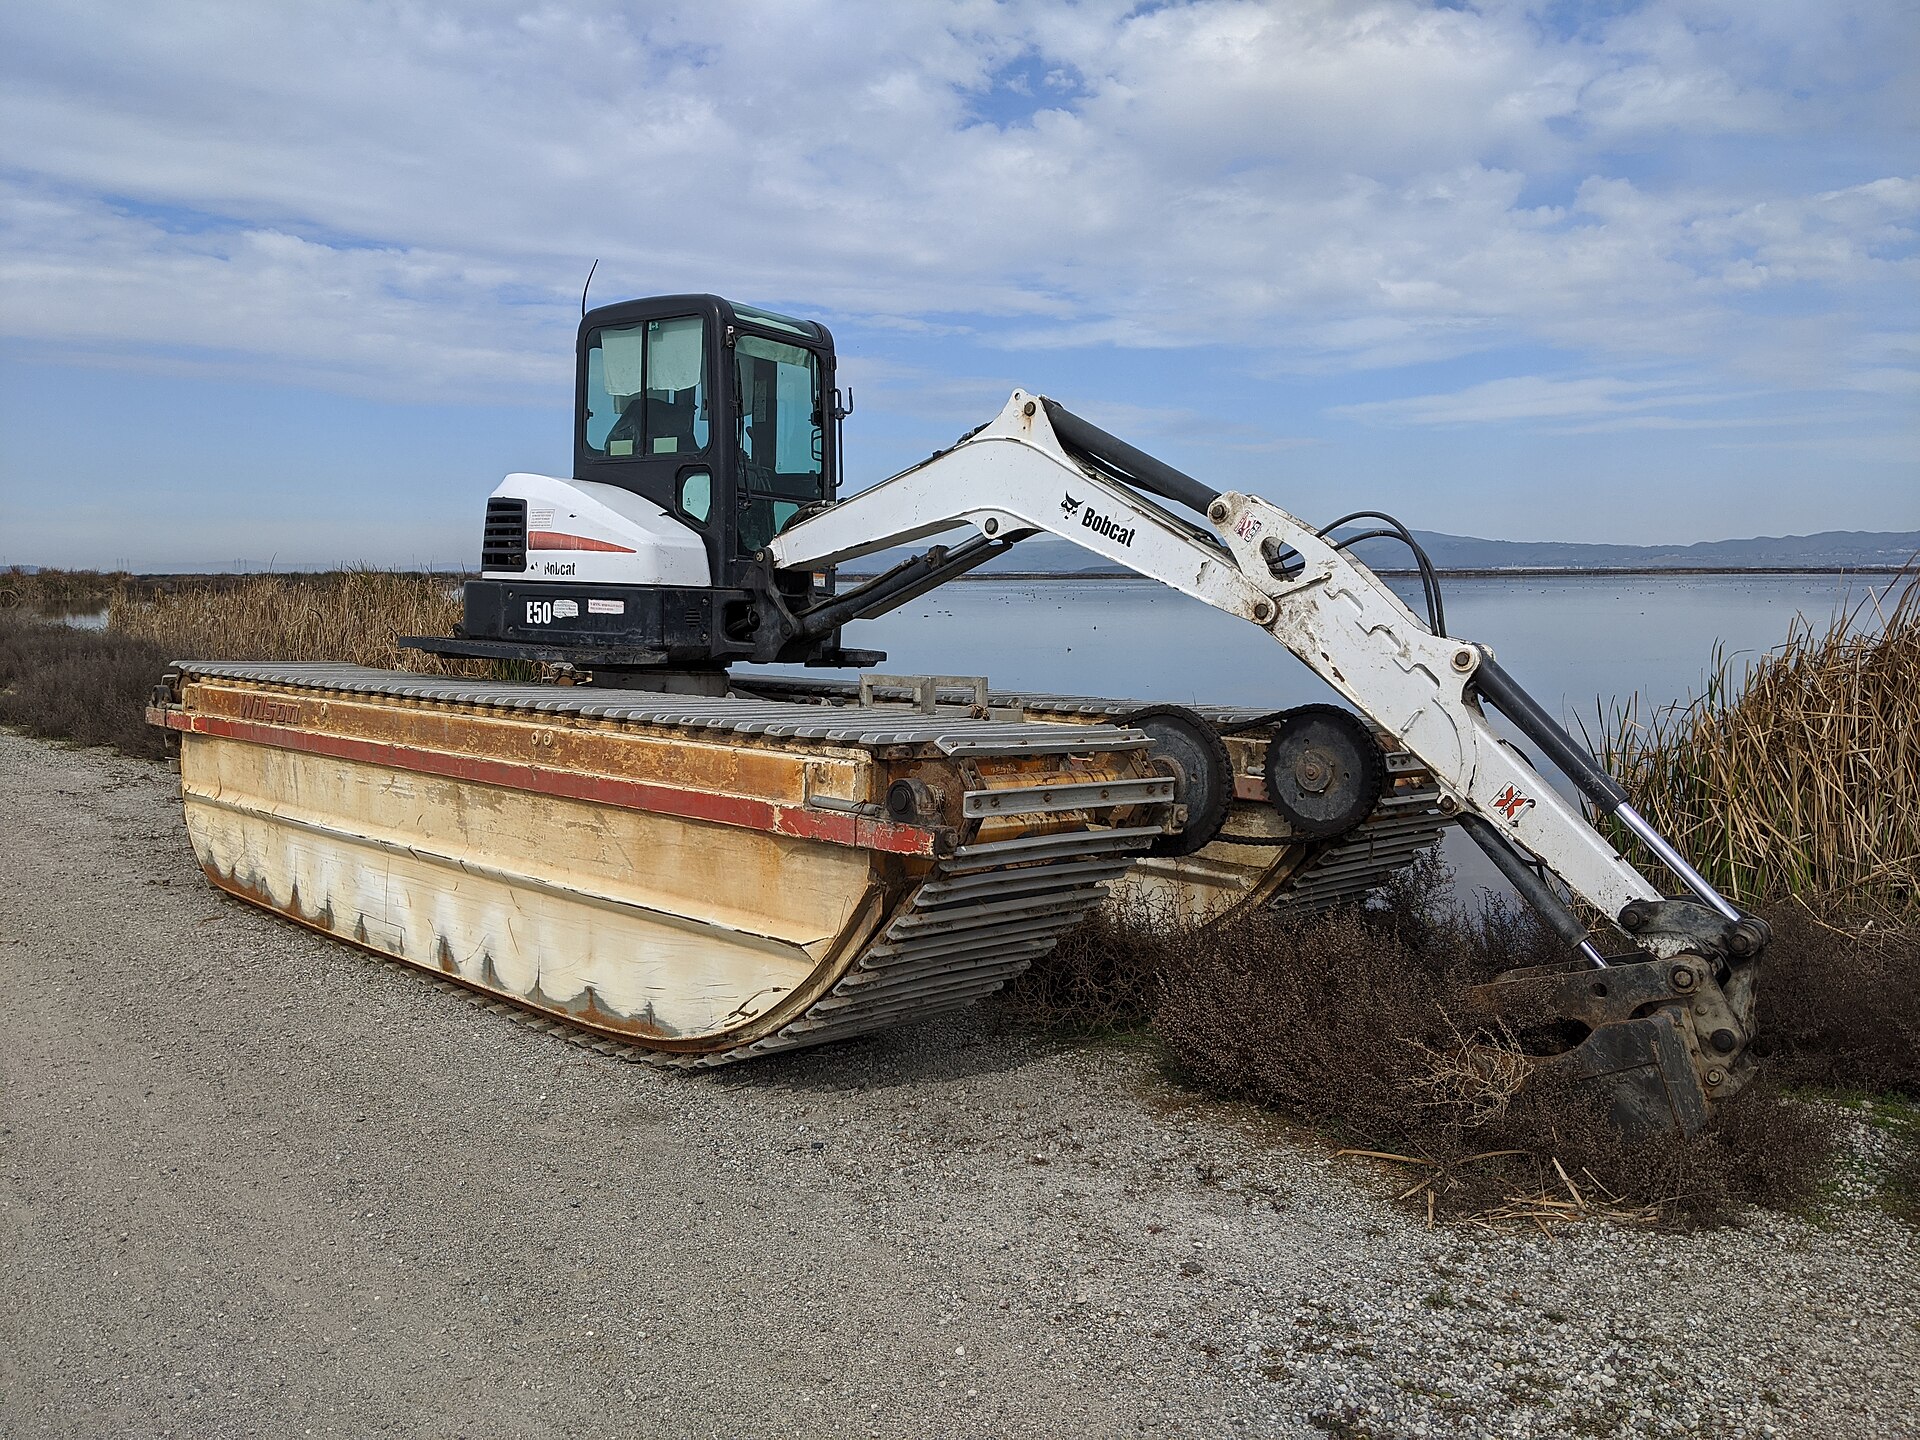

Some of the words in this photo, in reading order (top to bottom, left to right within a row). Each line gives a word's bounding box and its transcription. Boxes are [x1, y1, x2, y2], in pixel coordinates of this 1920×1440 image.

[1082, 507, 1135, 547] Bobcat
[1244, 521, 1260, 541] USA
[527, 602, 552, 624] E50
[240, 694, 300, 724] Wilson
